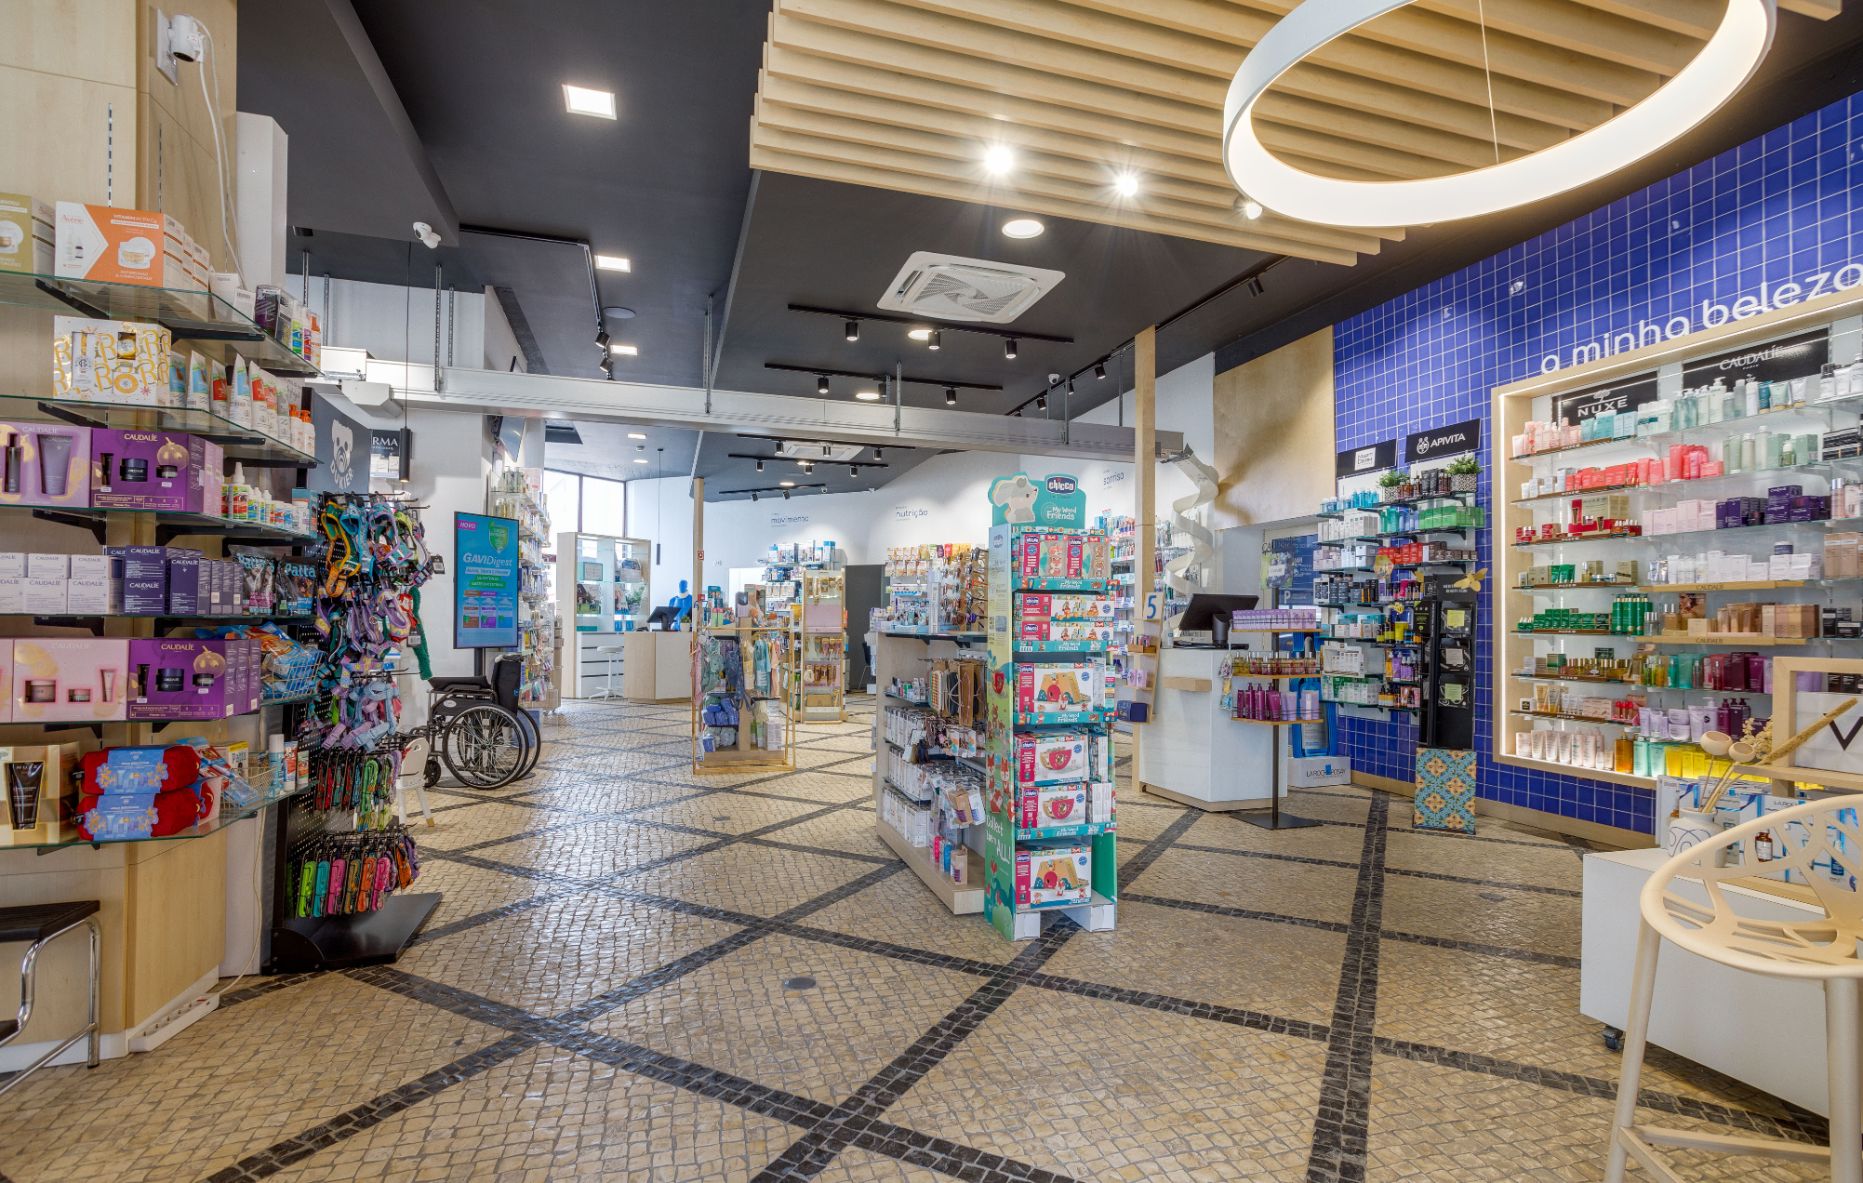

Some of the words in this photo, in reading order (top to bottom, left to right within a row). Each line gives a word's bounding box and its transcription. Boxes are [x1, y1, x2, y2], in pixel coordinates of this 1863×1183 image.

[1572, 318, 1690, 367] minha
[1702, 263, 1863, 329] beleza
[1577, 398, 1628, 418] NUXE
[1430, 433, 1466, 448] APIVITA
[1147, 594, 1157, 619] 5
